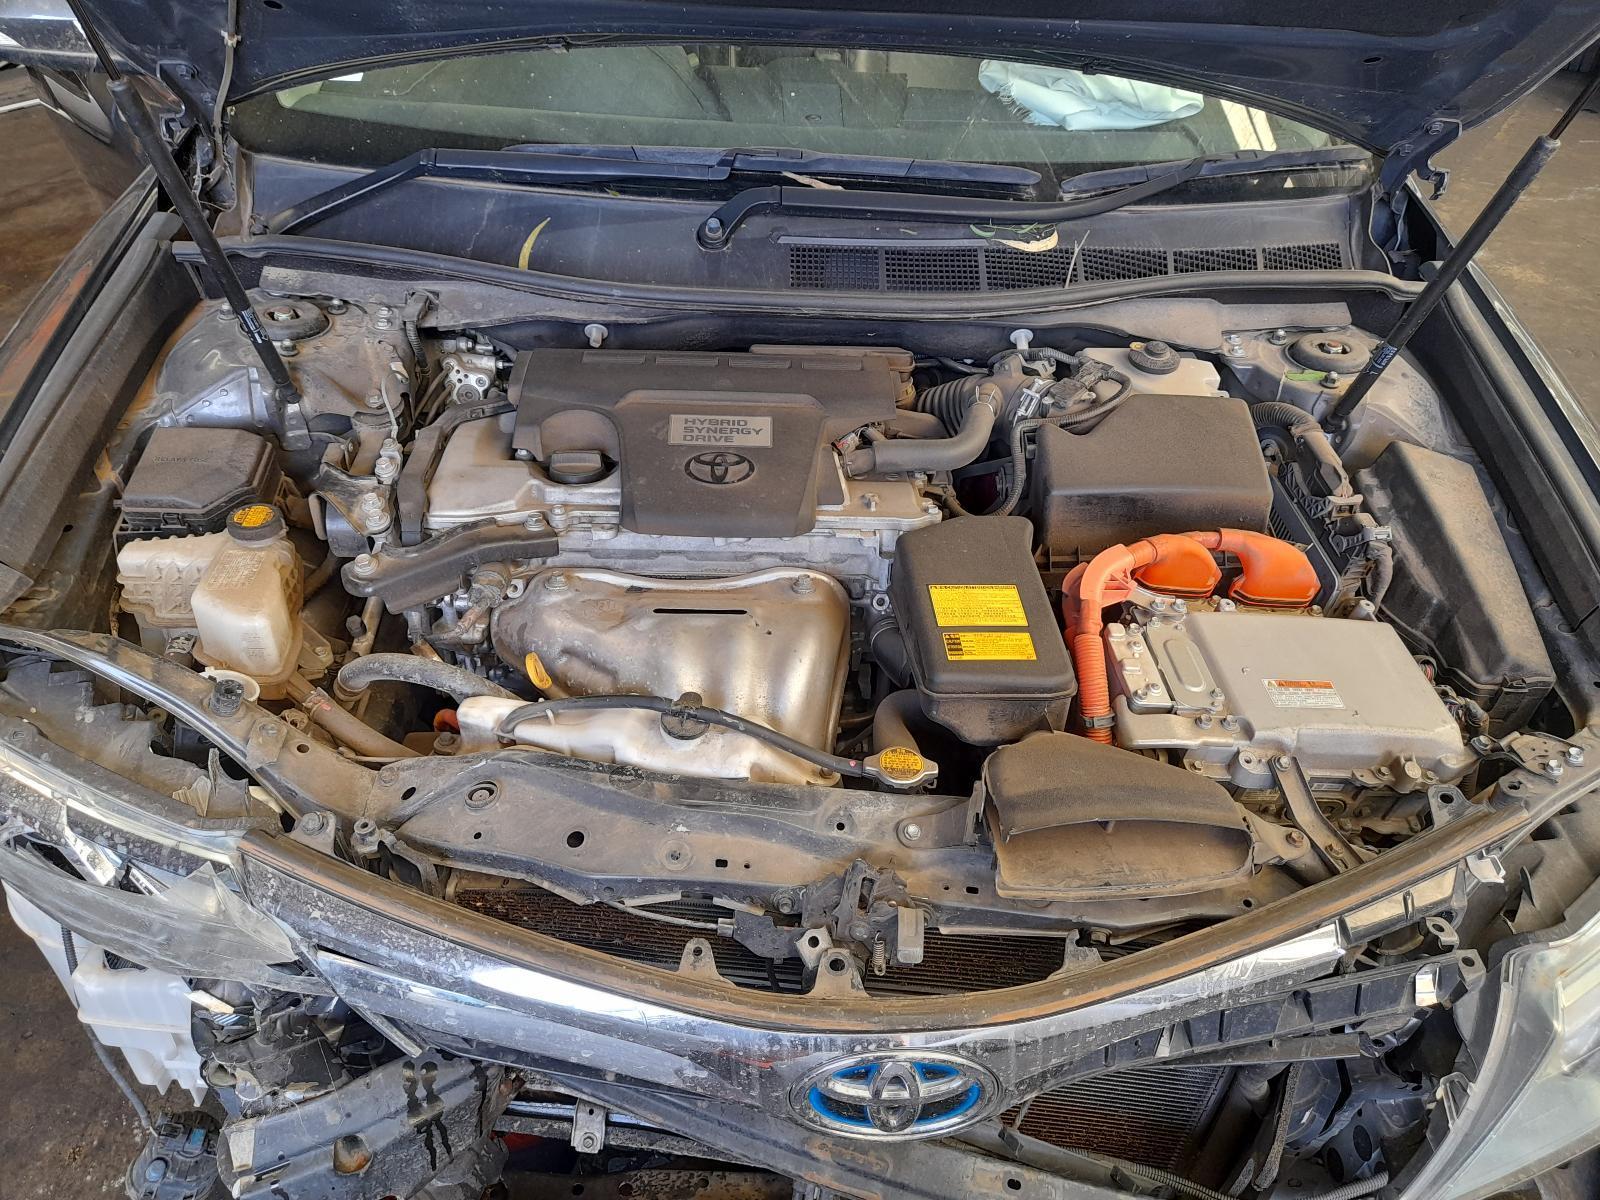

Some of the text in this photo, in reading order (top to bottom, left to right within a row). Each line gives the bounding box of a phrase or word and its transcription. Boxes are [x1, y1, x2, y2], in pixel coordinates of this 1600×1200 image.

[684, 418, 748, 426] HYBRID
[683, 426, 763, 435] SYNERGY
[682, 434, 735, 443] DRIVE
